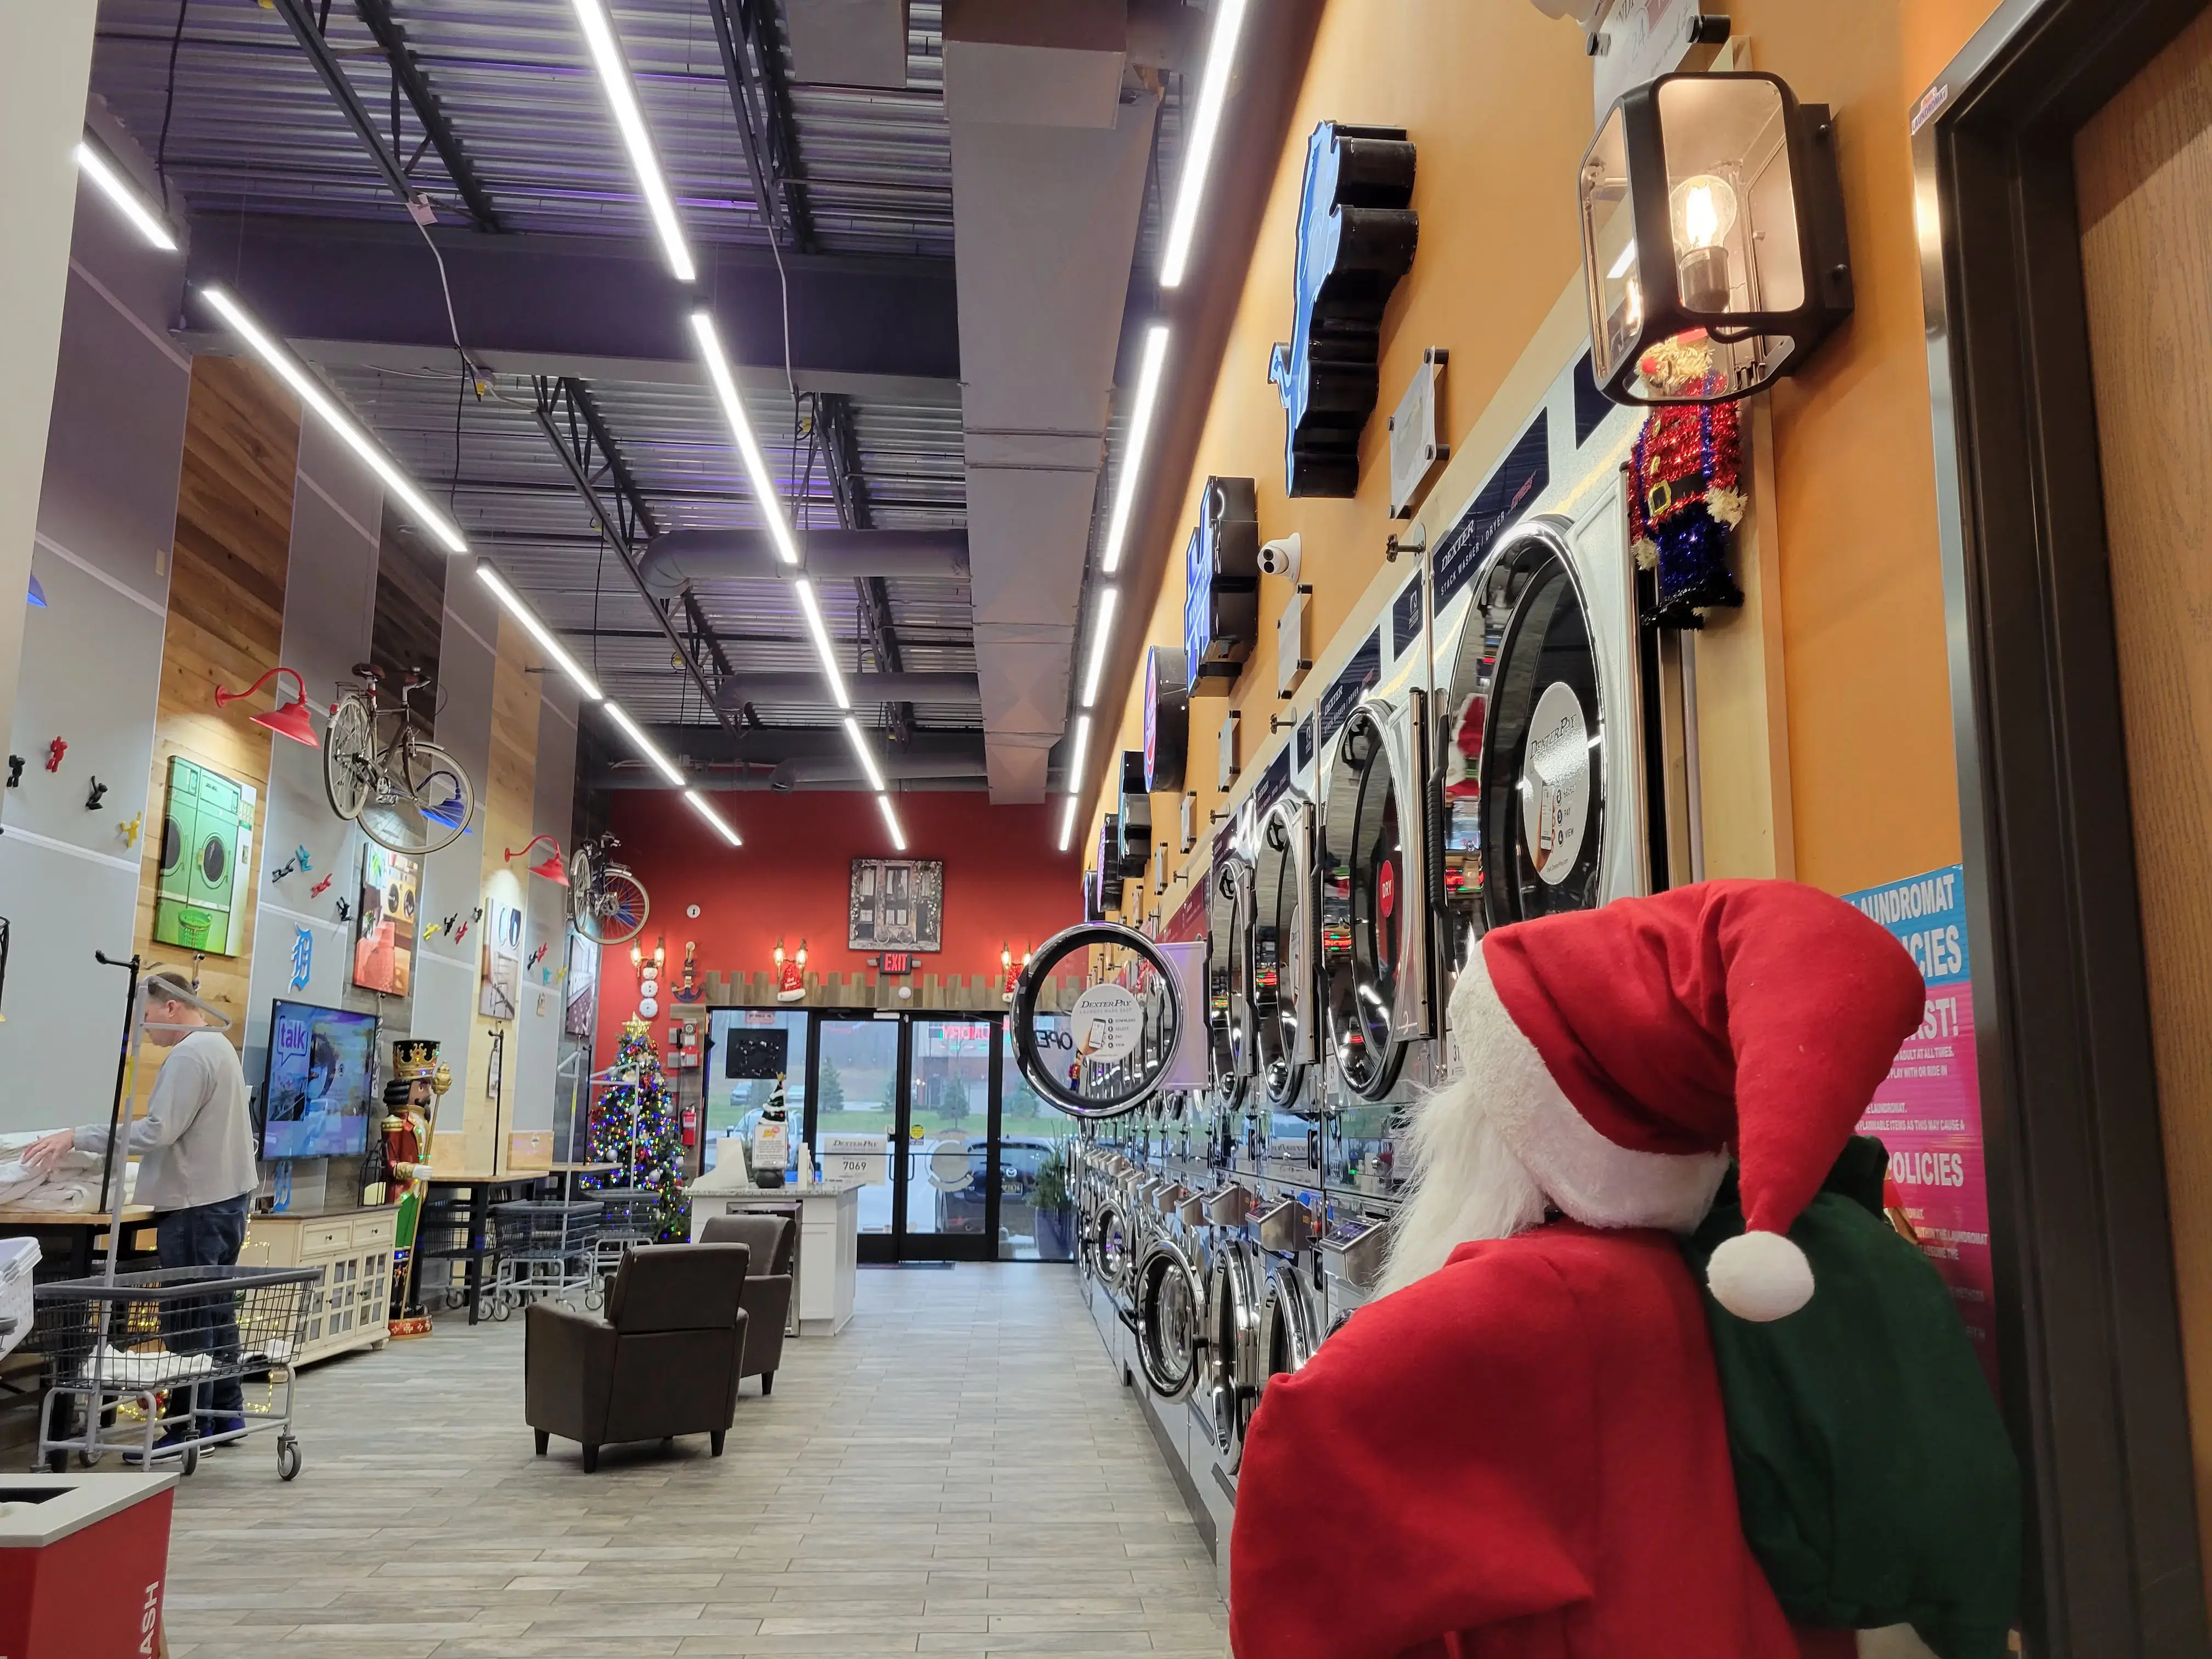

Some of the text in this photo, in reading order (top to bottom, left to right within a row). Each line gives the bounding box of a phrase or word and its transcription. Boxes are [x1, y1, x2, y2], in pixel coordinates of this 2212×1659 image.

[1912, 89, 1945, 131] LAUNDROMAT
[1441, 519, 1474, 573] DEXTER
[1441, 574, 1457, 596] STACK
[1458, 542, 1479, 574] WASHER
[1486, 510, 1505, 541] DRYER
[1189, 555, 1212, 630] MICHIGAN
[1324, 685, 1343, 716] DEXTER
[1565, 827, 1573, 839] VIEW
[1383, 879, 1392, 899] DRY
[1851, 874, 1954, 926] AUNDROMAT
[884, 953, 907, 971] EXIT
[1903, 997, 1959, 1041] ST!
[280, 1024, 306, 1049] talk
[1453, 1045, 1460, 1062] 31
[1900, 1048, 1916, 1060] ADULT
[1917, 1048, 1924, 1059] AT
[1924, 1047, 1934, 1059] ALL
[1934, 1046, 1954, 1058] TIMES.
[1891, 1068, 1903, 1079] PLAY
[1904, 1067, 1918, 1078] WITH
[1918, 1066, 1927, 1077] OR
[1927, 1065, 1940, 1076] RIDE
[1940, 1065, 1948, 1076] IN
[1890, 1120, 1906, 1131] ITEMS
[1907, 1120, 1914, 1130] AS
[1915, 1120, 1928, 1131] THIS
[1928, 1120, 1940, 1131] MAY
[1940, 1119, 1959, 1131] CAUSE
[843, 1161, 867, 1171] 7069
[140, 1581, 159, 1659] ASH
